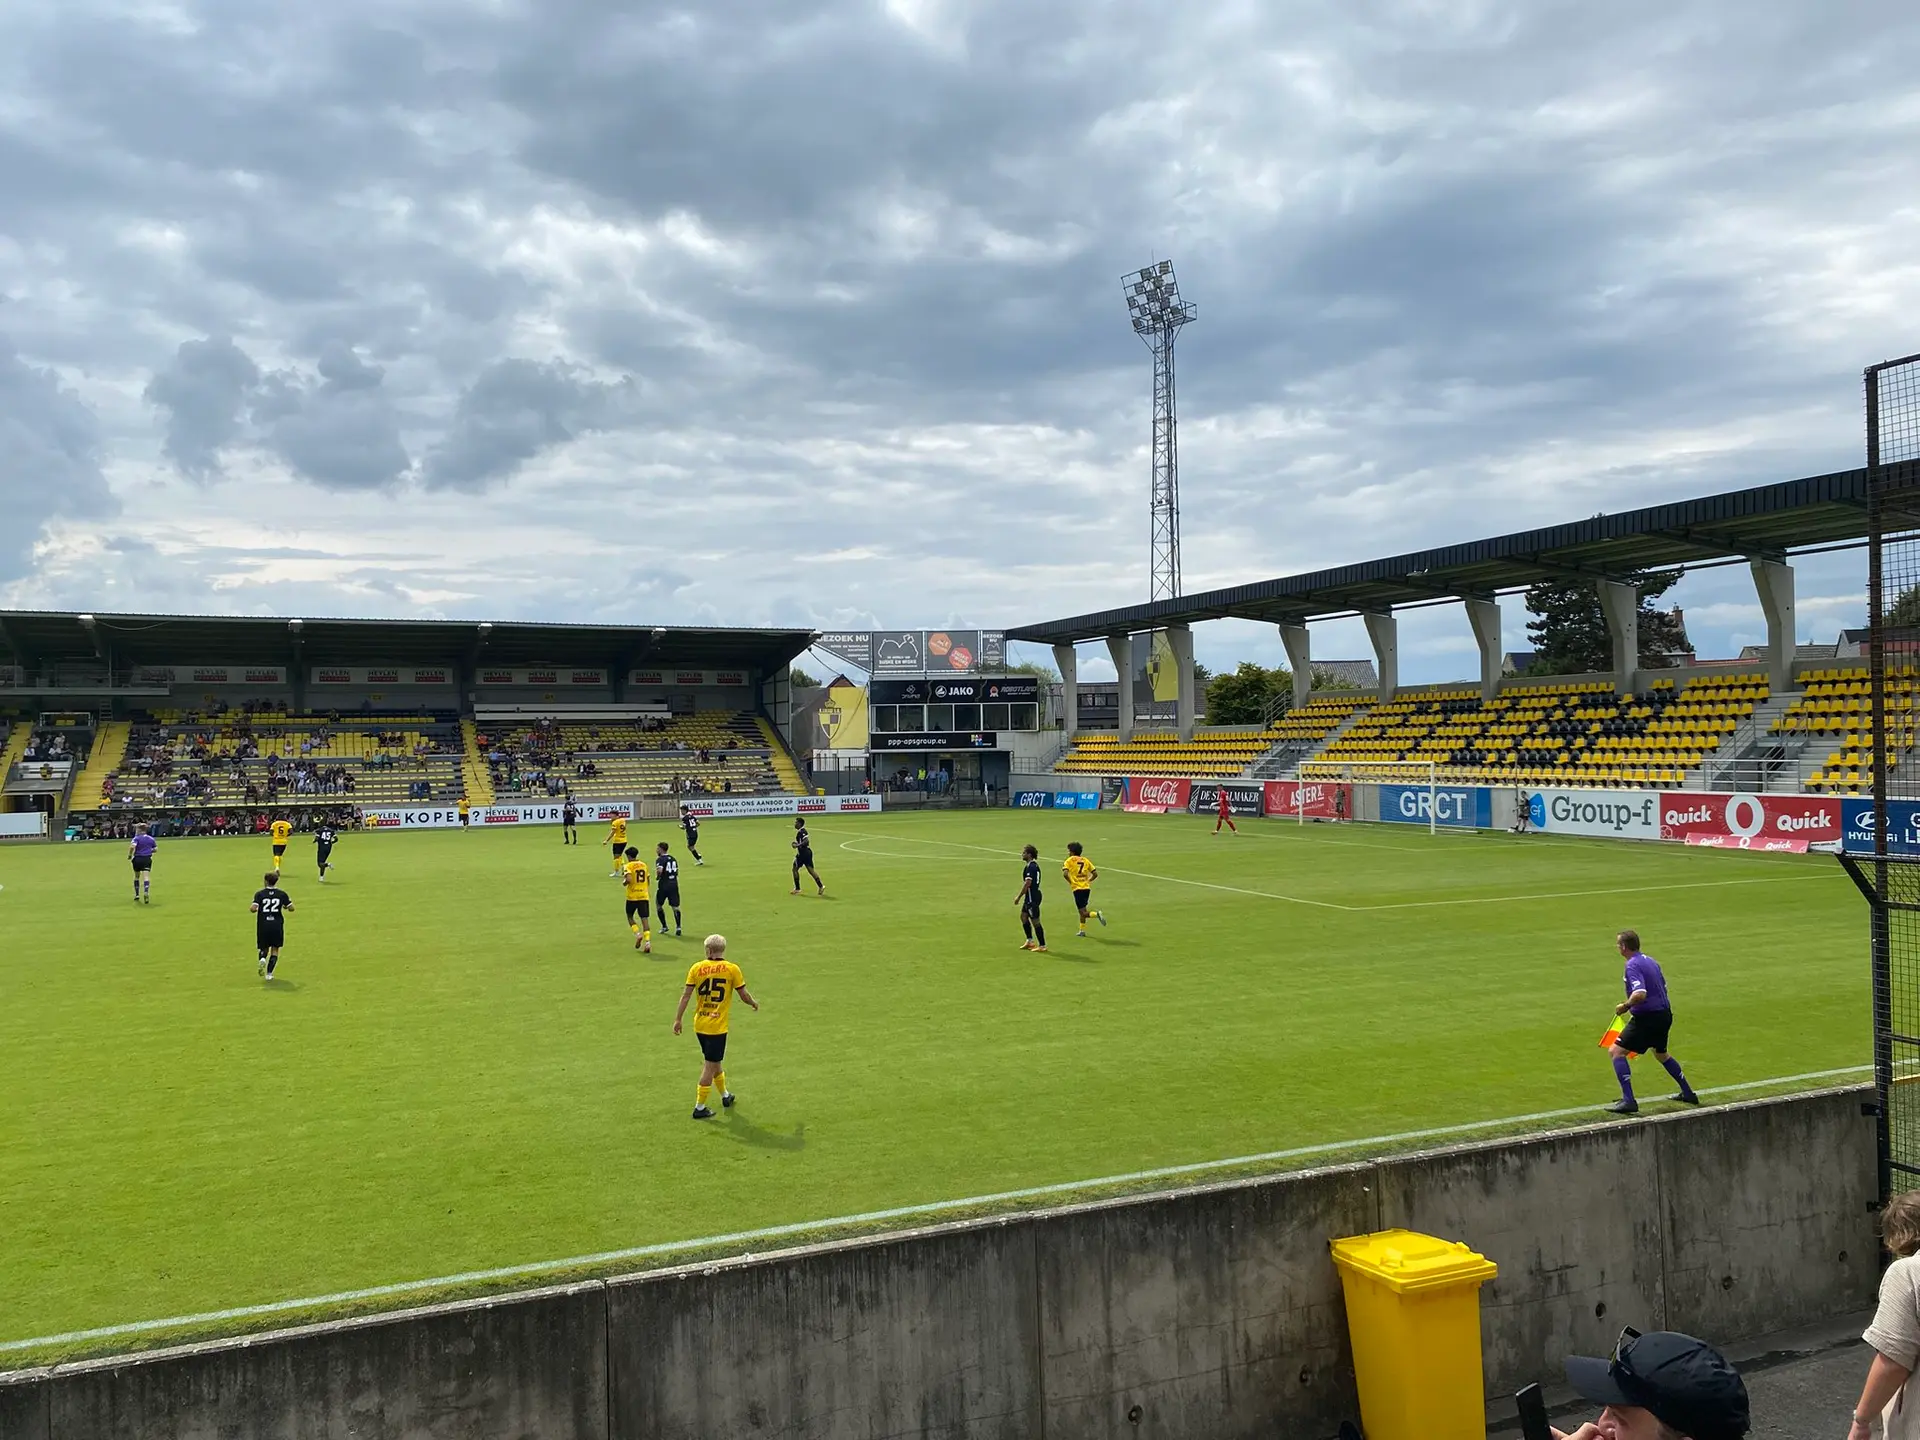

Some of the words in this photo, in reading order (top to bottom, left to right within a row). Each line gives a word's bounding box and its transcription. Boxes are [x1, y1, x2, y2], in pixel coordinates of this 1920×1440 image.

[855, 634, 869, 642] NU
[948, 686, 974, 696] JAKO
[1000, 685, 1038, 693] ROBOTLAND
[887, 738, 947, 746] ppp-apsgroup.eu
[1140, 780, 1180, 805] Coca-Cola
[1200, 790, 1211, 801] DE
[1211, 790, 1260, 803] STLMAKER
[1020, 793, 1046, 807] GRCT
[1399, 791, 1467, 819] GRCT
[485, 808, 518, 816] HEYLEN
[1551, 796, 1653, 831] Group-f
[1664, 804, 1713, 827] Quick
[1776, 809, 1832, 832] Quick
[278, 826, 284, 834] 6
[619, 824, 626, 833] 9
[321, 832, 331, 840] 45
[1848, 831, 1898, 843] HYUAI
[1699, 836, 1725, 847] Quick
[1765, 840, 1793, 852] Quick
[665, 861, 677, 873] 44
[1076, 861, 1085, 874] 7
[262, 898, 280, 912] 22
[697, 977, 727, 1003] 45
